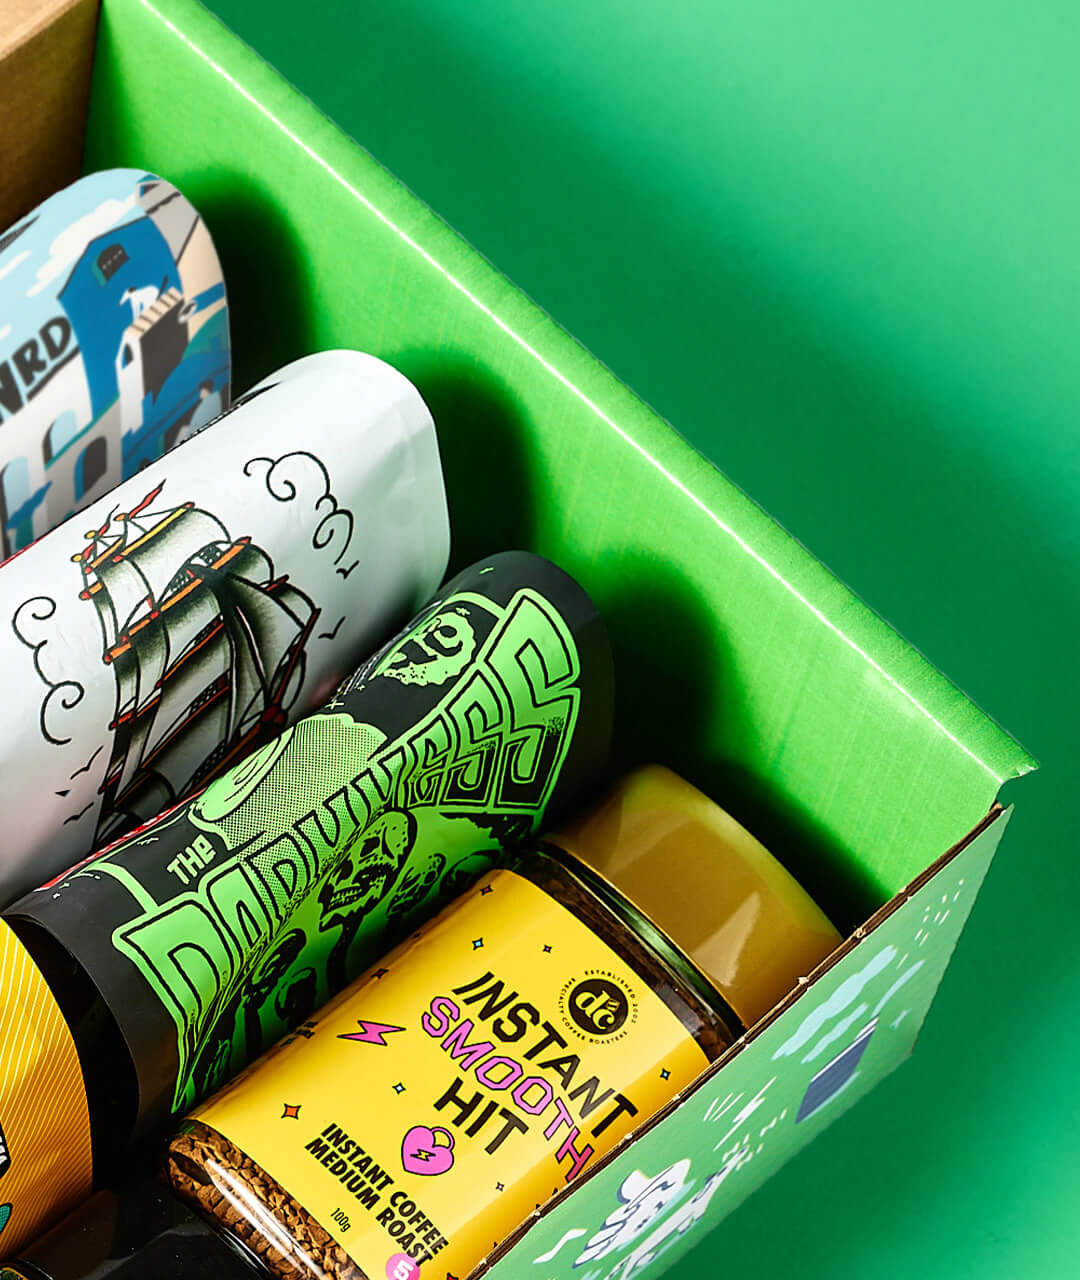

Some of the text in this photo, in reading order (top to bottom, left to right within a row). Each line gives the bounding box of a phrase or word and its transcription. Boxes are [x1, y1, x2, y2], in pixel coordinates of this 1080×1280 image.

[421, 997, 593, 1181] SMOOTH
[452, 971, 638, 1137] INSTANT
[562, 1017, 586, 1040] COFFEE
[589, 1031, 628, 1045] ROASTERS
[433, 1077, 529, 1157] HIT
[304, 1137, 435, 1267] MEDIUM ROAST
[320, 1123, 449, 1256] INSTANT COFFEE
[330, 1206, 353, 1233] 100g
